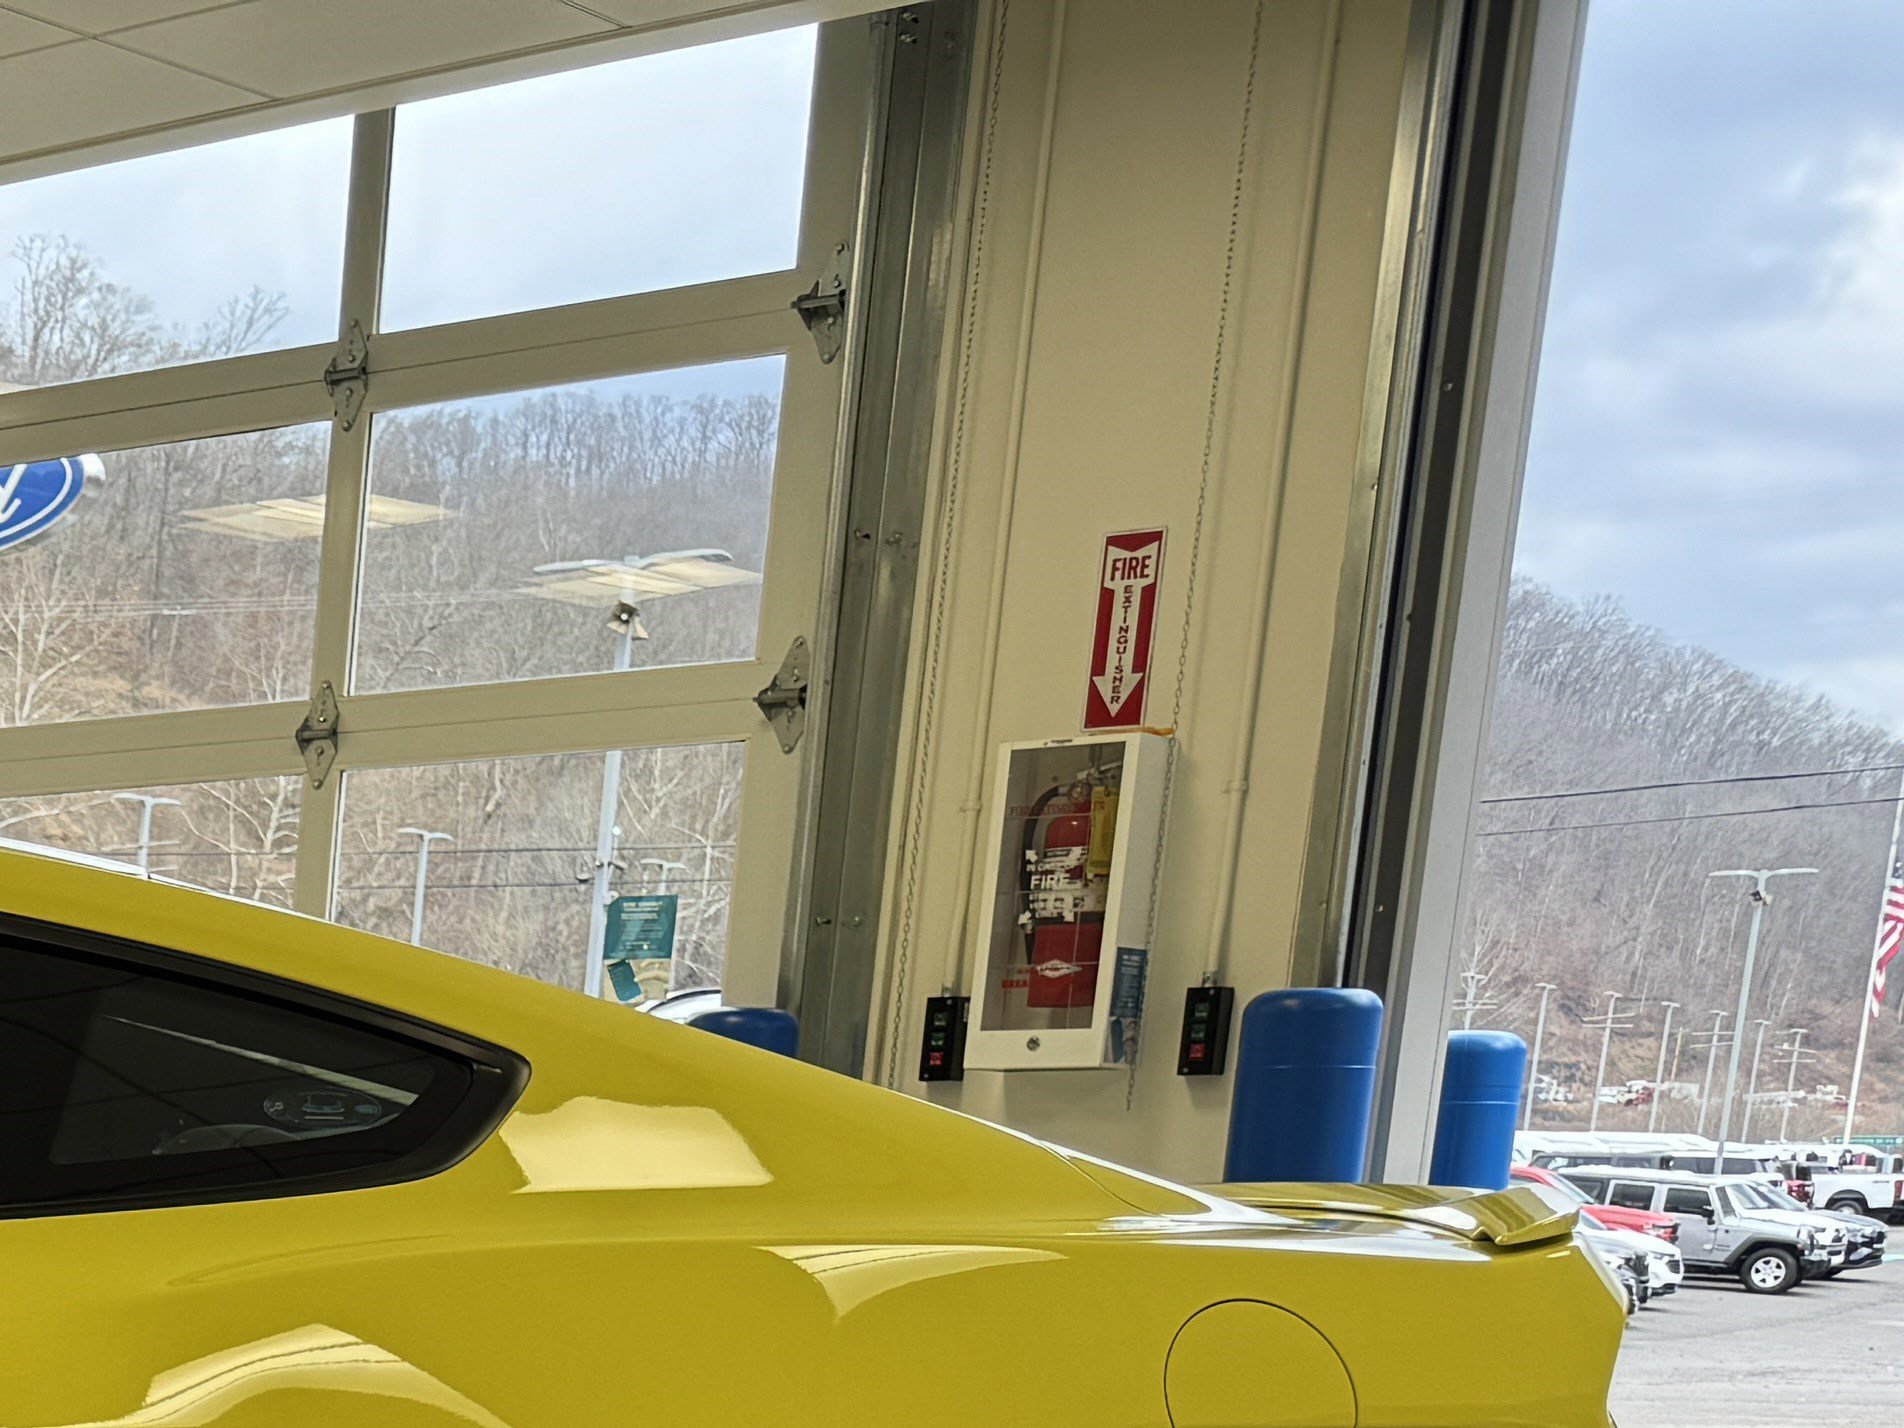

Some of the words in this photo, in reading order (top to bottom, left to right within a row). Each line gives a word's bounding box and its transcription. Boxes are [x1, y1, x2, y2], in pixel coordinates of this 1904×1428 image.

[1109, 555, 1152, 582] FIRE
[1110, 584, 1134, 705] EXTINGUISHER
[1030, 873, 1071, 890] FIRE
